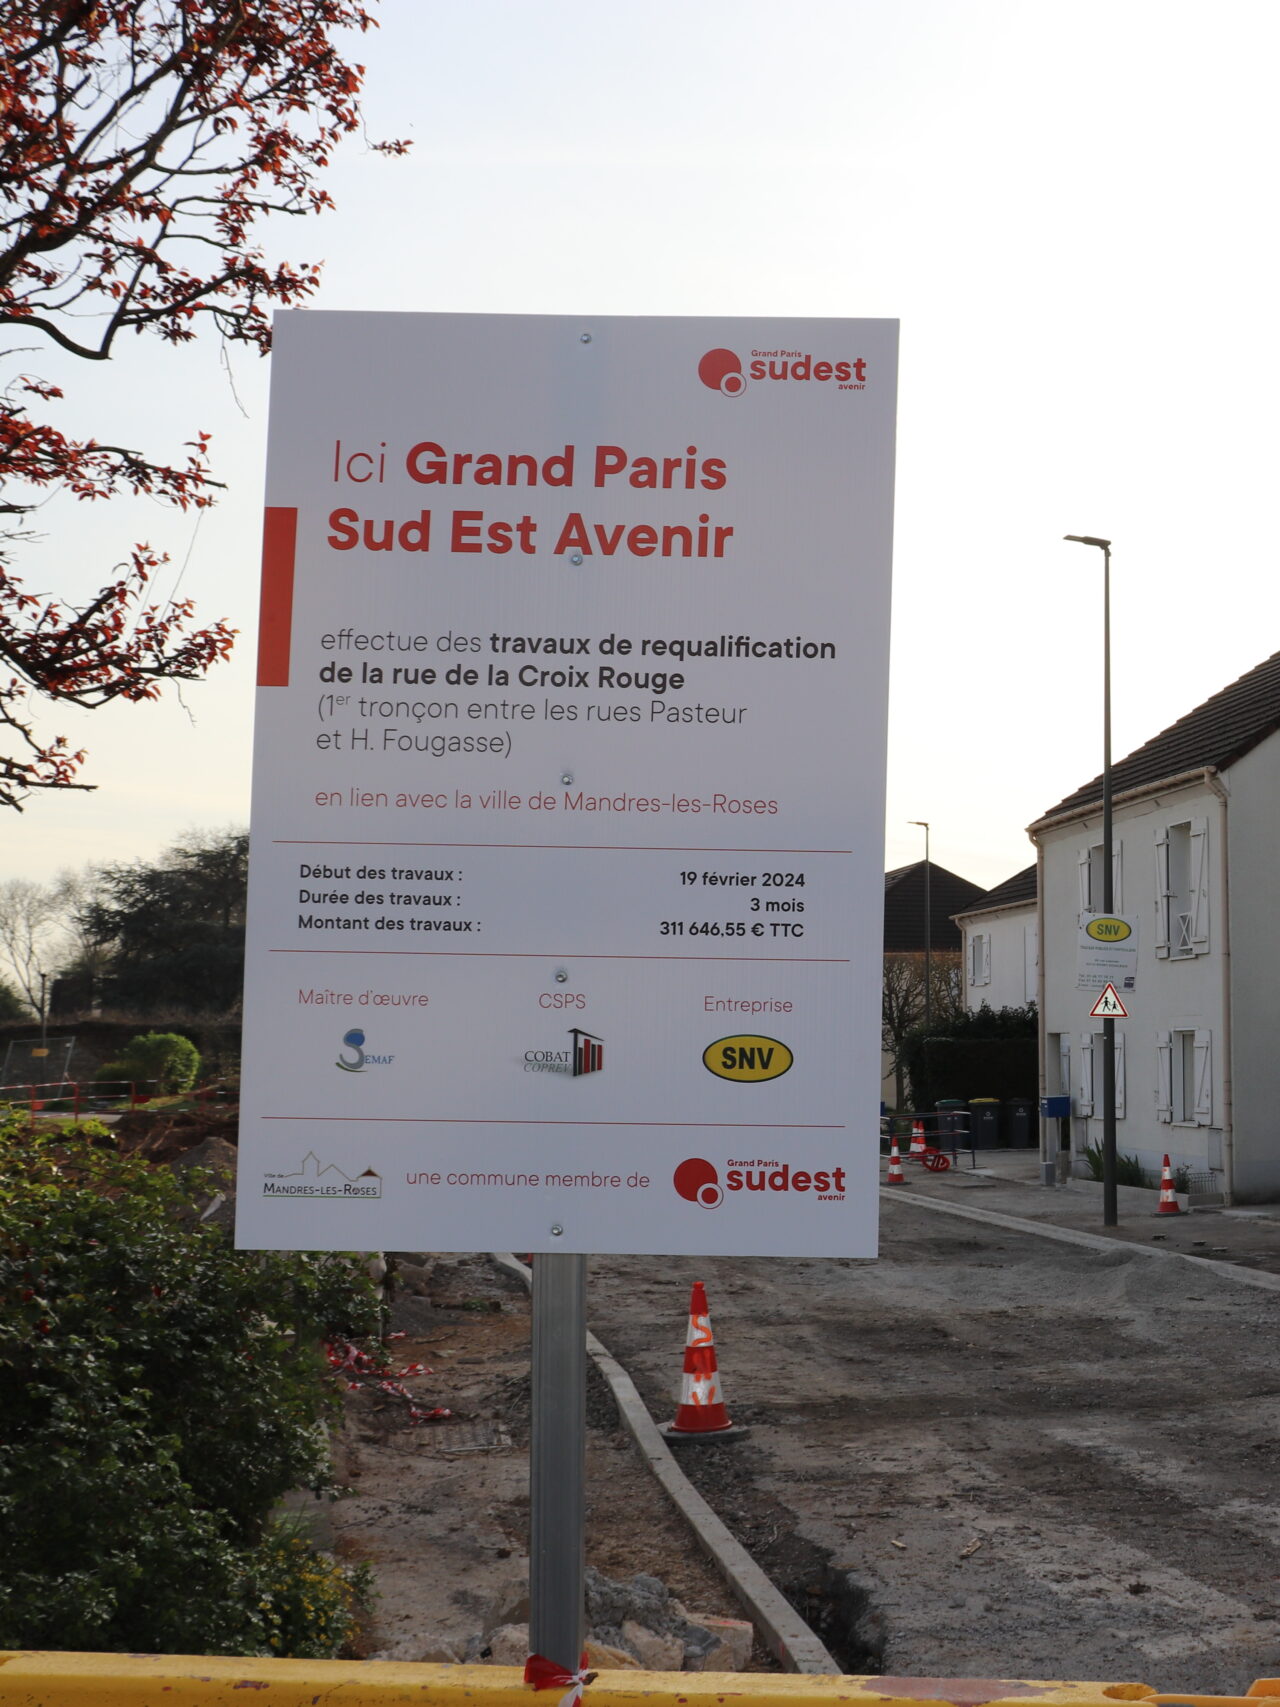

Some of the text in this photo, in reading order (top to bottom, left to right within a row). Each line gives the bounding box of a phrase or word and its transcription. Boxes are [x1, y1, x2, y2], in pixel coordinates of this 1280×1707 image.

[751, 350, 802, 358] Grand Paris
[750, 354, 867, 382] sudest
[838, 383, 866, 391] avenir
[334, 440, 726, 490] Ici Grand Paris
[328, 508, 734, 557] Sud Est Avenir
[321, 628, 835, 661] effectue des travaux de requalification
[319, 661, 684, 694] de la rue de la Croix Rouge
[358, 697, 458, 723] tronçon
[467, 700, 535, 720] entre
[545, 699, 577, 721] les
[587, 706, 641, 722] rues
[651, 700, 747, 724] Pasteur
[317, 728, 511, 758] et H. Fougasse)
[315, 788, 778, 814] en lien avec la ville de Mandres-les-Roses
[300, 864, 351, 879] Début
[356, 866, 386, 879] des
[391, 868, 453, 881] travaux
[680, 871, 805, 887] 19 février 2024
[299, 889, 349, 904] Durée
[354, 891, 384, 904] des
[389, 893, 451, 906] travaux
[751, 898, 804, 912] 3 mois
[299, 915, 369, 930] Montant
[374, 917, 405, 931] des
[410, 918, 473, 932] travaux
[660, 921, 803, 937] 311 646,55 € TTC
[1097, 924, 1120, 936] SNV
[299, 989, 353, 1005] Maître
[539, 993, 586, 1009] CSPS
[705, 996, 793, 1015] Entreprise
[524, 1050, 572, 1063] COBAT
[721, 1047, 774, 1069] SNV
[727, 1158, 780, 1168] Grand Paris
[407, 1171, 650, 1188] une commune membre de
[726, 1164, 846, 1193] sudest
[817, 1193, 846, 1201] avenir
